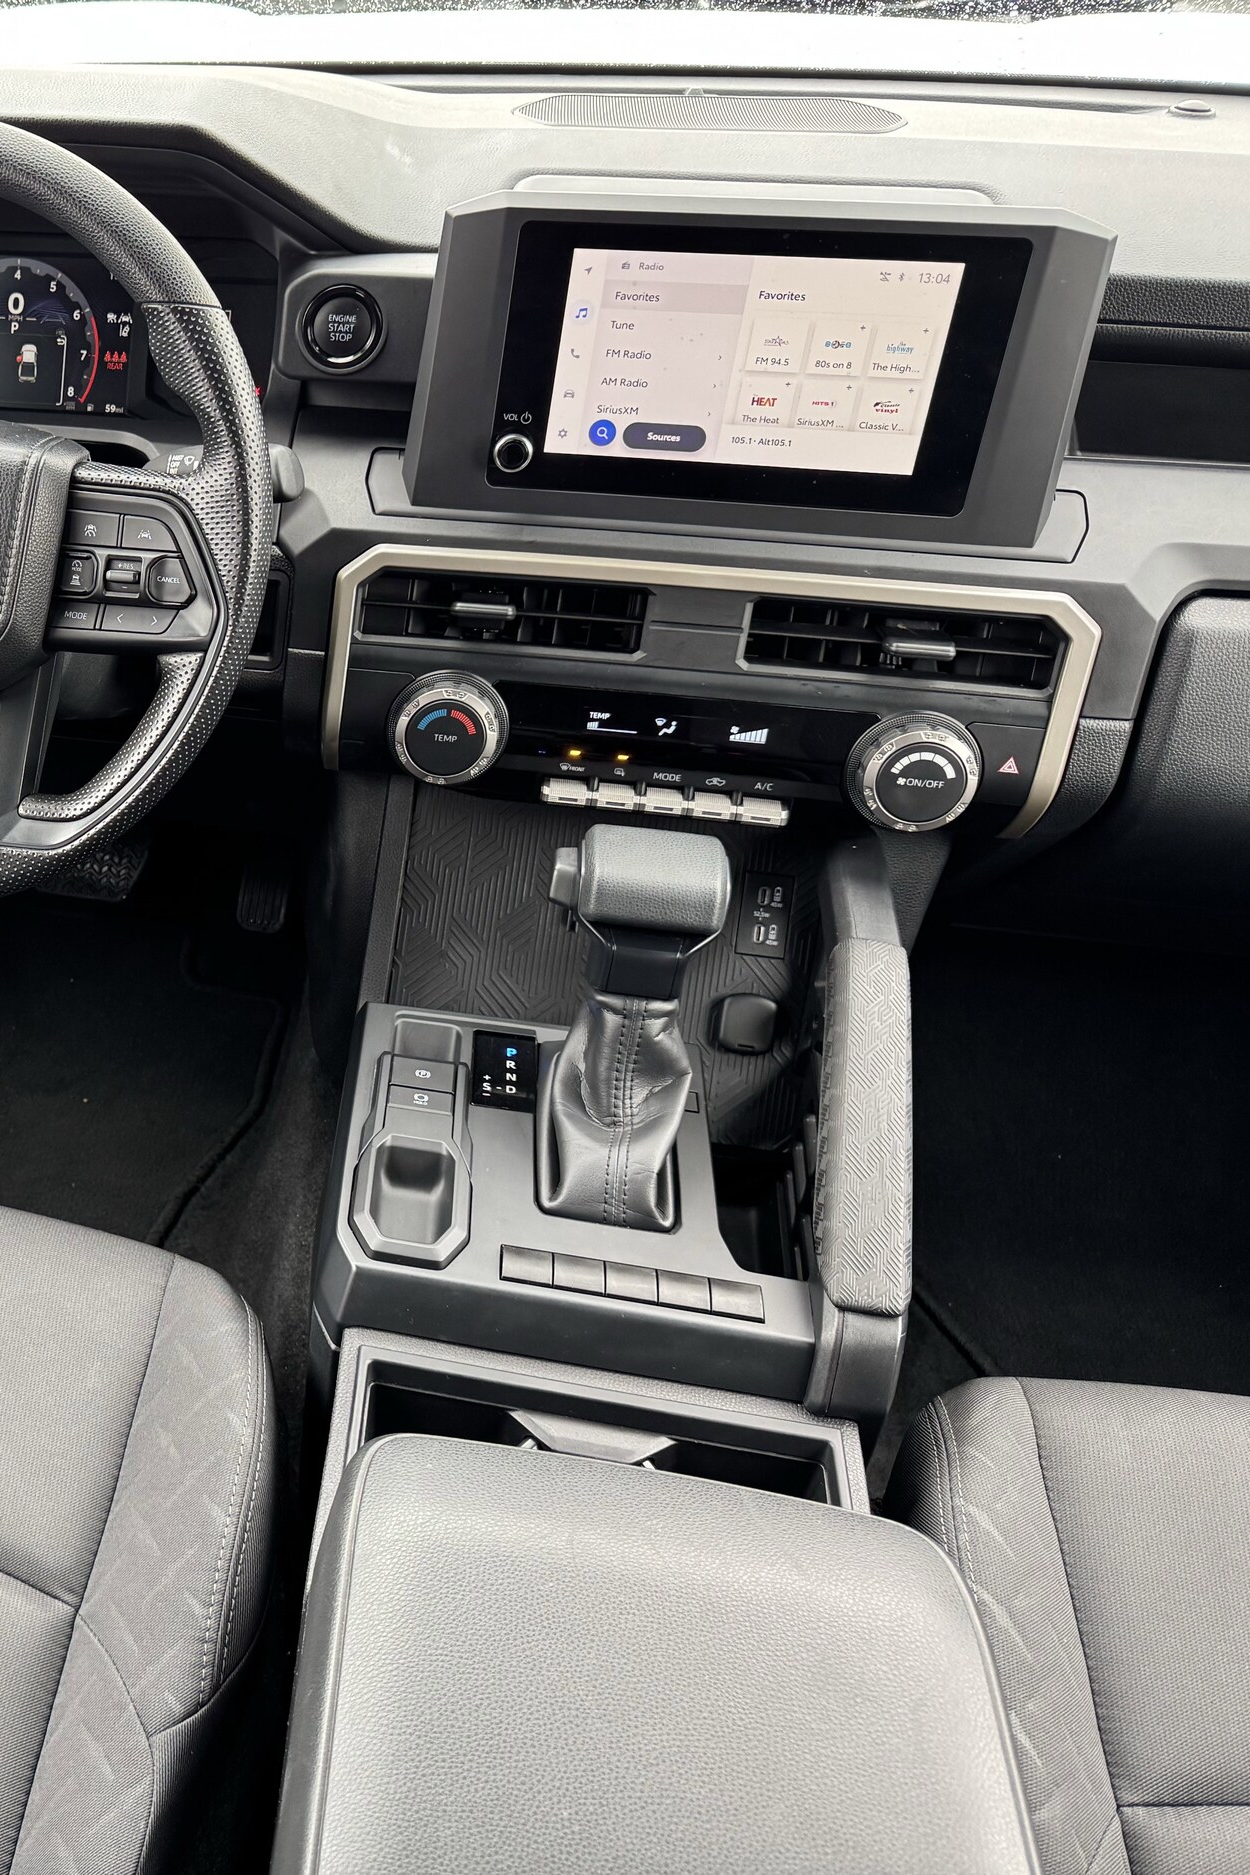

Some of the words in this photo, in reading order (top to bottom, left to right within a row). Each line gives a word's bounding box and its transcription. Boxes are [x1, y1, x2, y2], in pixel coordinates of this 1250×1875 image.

[638, 262, 665, 272] Radio
[14, 269, 21, 280] 4
[918, 272, 951, 284] 13:04
[50, 281, 57, 292] 5
[615, 291, 660, 303] Favorites
[758, 290, 806, 302] Favorites
[8, 292, 25, 315] 0
[73, 310, 81, 321] 6
[328, 314, 357, 323] ENGINE
[11, 322, 20, 334] P
[328, 323, 355, 333] START
[610, 320, 635, 331] Tune
[330, 332, 353, 342] STOP
[886, 344, 914, 354] highway
[80, 350, 88, 361] 7
[605, 349, 621, 359] FM
[623, 350, 652, 360] Radio
[107, 363, 124, 371] REAR
[755, 357, 769, 366] FM
[770, 357, 790, 367] 94.5
[815, 360, 831, 369] 80s
[846, 361, 853, 370] 8
[872, 362, 888, 372] The
[601, 377, 618, 387] AM
[619, 378, 648, 388] Radio
[67, 386, 75, 397] 8
[751, 396, 778, 407] HEAT
[597, 405, 639, 416] SiriusXM
[503, 413, 519, 421] VOL
[742, 415, 757, 424] The
[759, 416, 780, 425] Heat
[796, 418, 834, 428] SiriusXM
[859, 421, 889, 431] Classic
[647, 432, 681, 442] Sources
[758, 437, 792, 447] Alt105.1
[156, 576, 181, 584] CANCEL
[64, 611, 88, 620] MODE
[589, 711, 612, 720] TEMP
[434, 733, 458, 743] TEMP
[653, 771, 682, 782] MODE
[754, 782, 774, 791] A/C
[906, 778, 945, 789] ON/OFF
[506, 1047, 518, 1057] P
[506, 1060, 517, 1070] R
[505, 1072, 517, 1082] N
[482, 1082, 491, 1091] S
[505, 1085, 517, 1094] D
